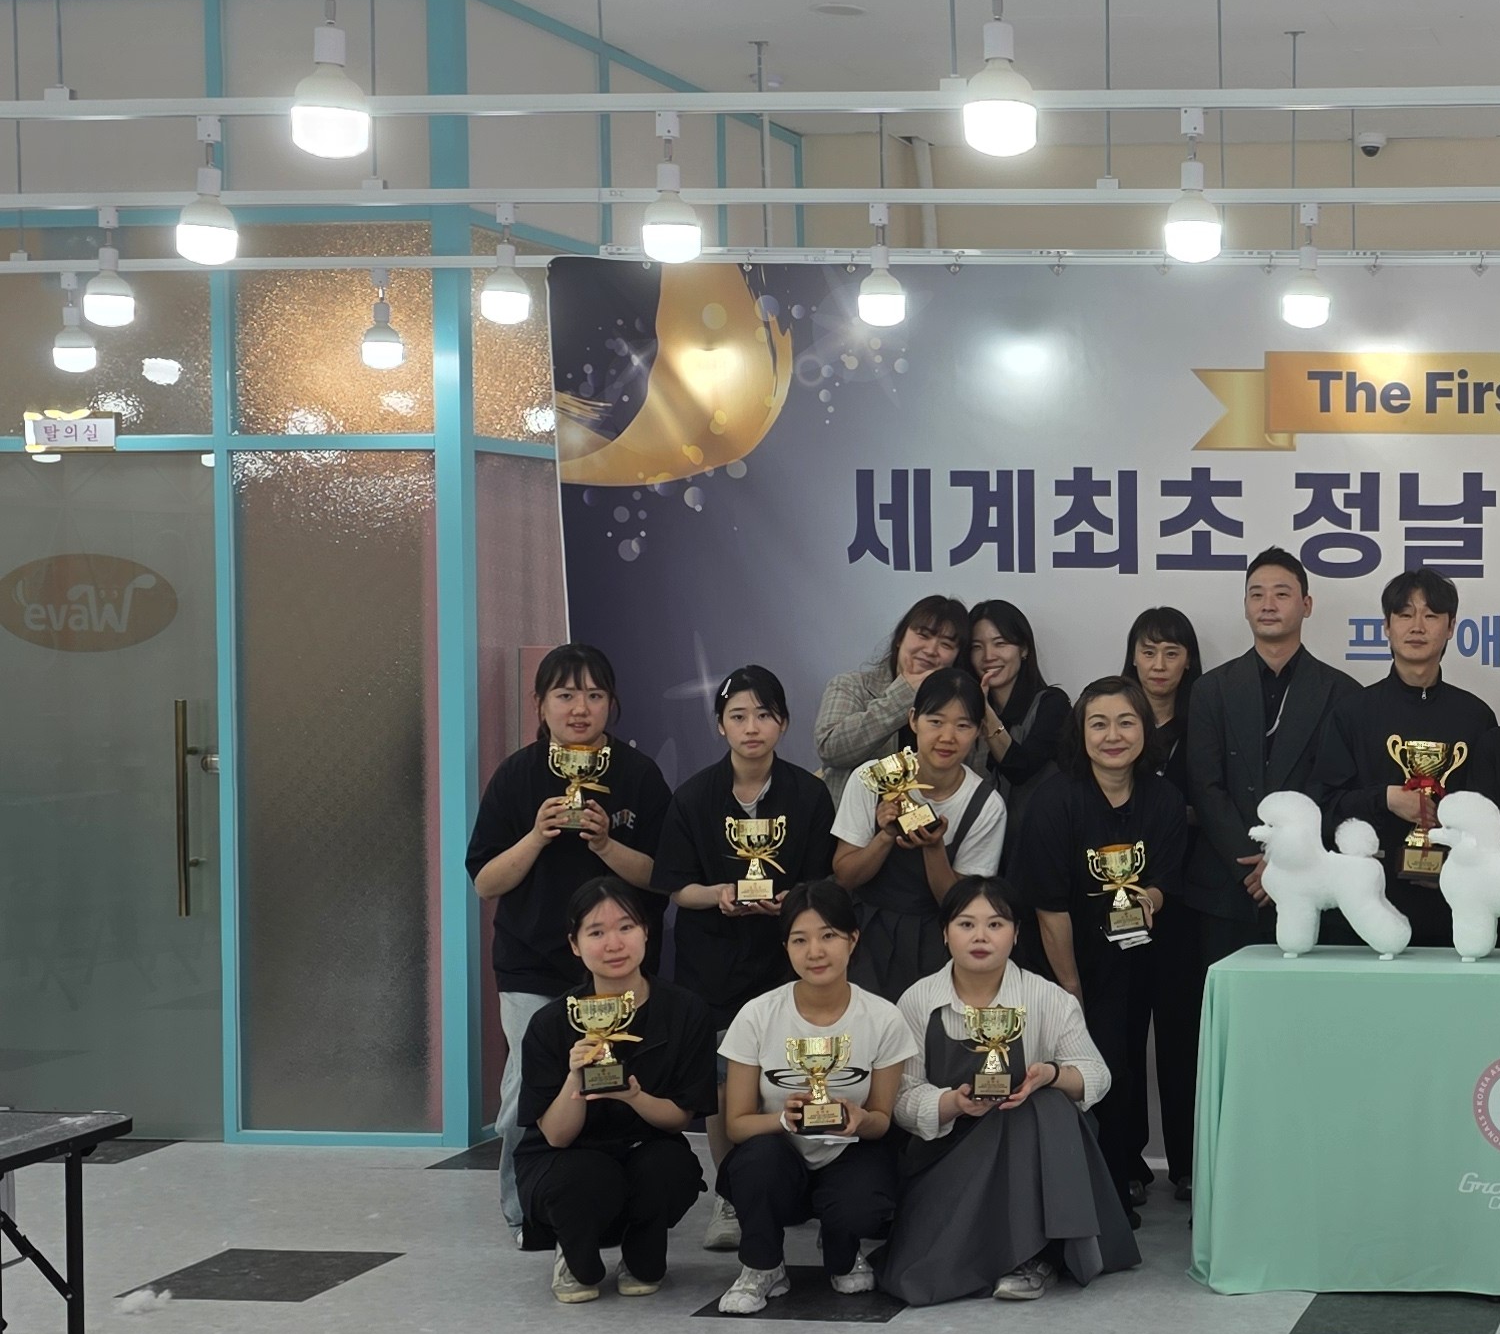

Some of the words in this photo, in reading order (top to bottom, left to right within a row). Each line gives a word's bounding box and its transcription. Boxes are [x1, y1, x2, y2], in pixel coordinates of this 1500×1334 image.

[1307, 371, 1411, 415] The
[43, 423, 99, 443] 탈의실
[847, 467, 1247, 575] 세계최초
[1292, 471, 1497, 579] 정날
[1476, 1076, 1491, 1106] KOREA
